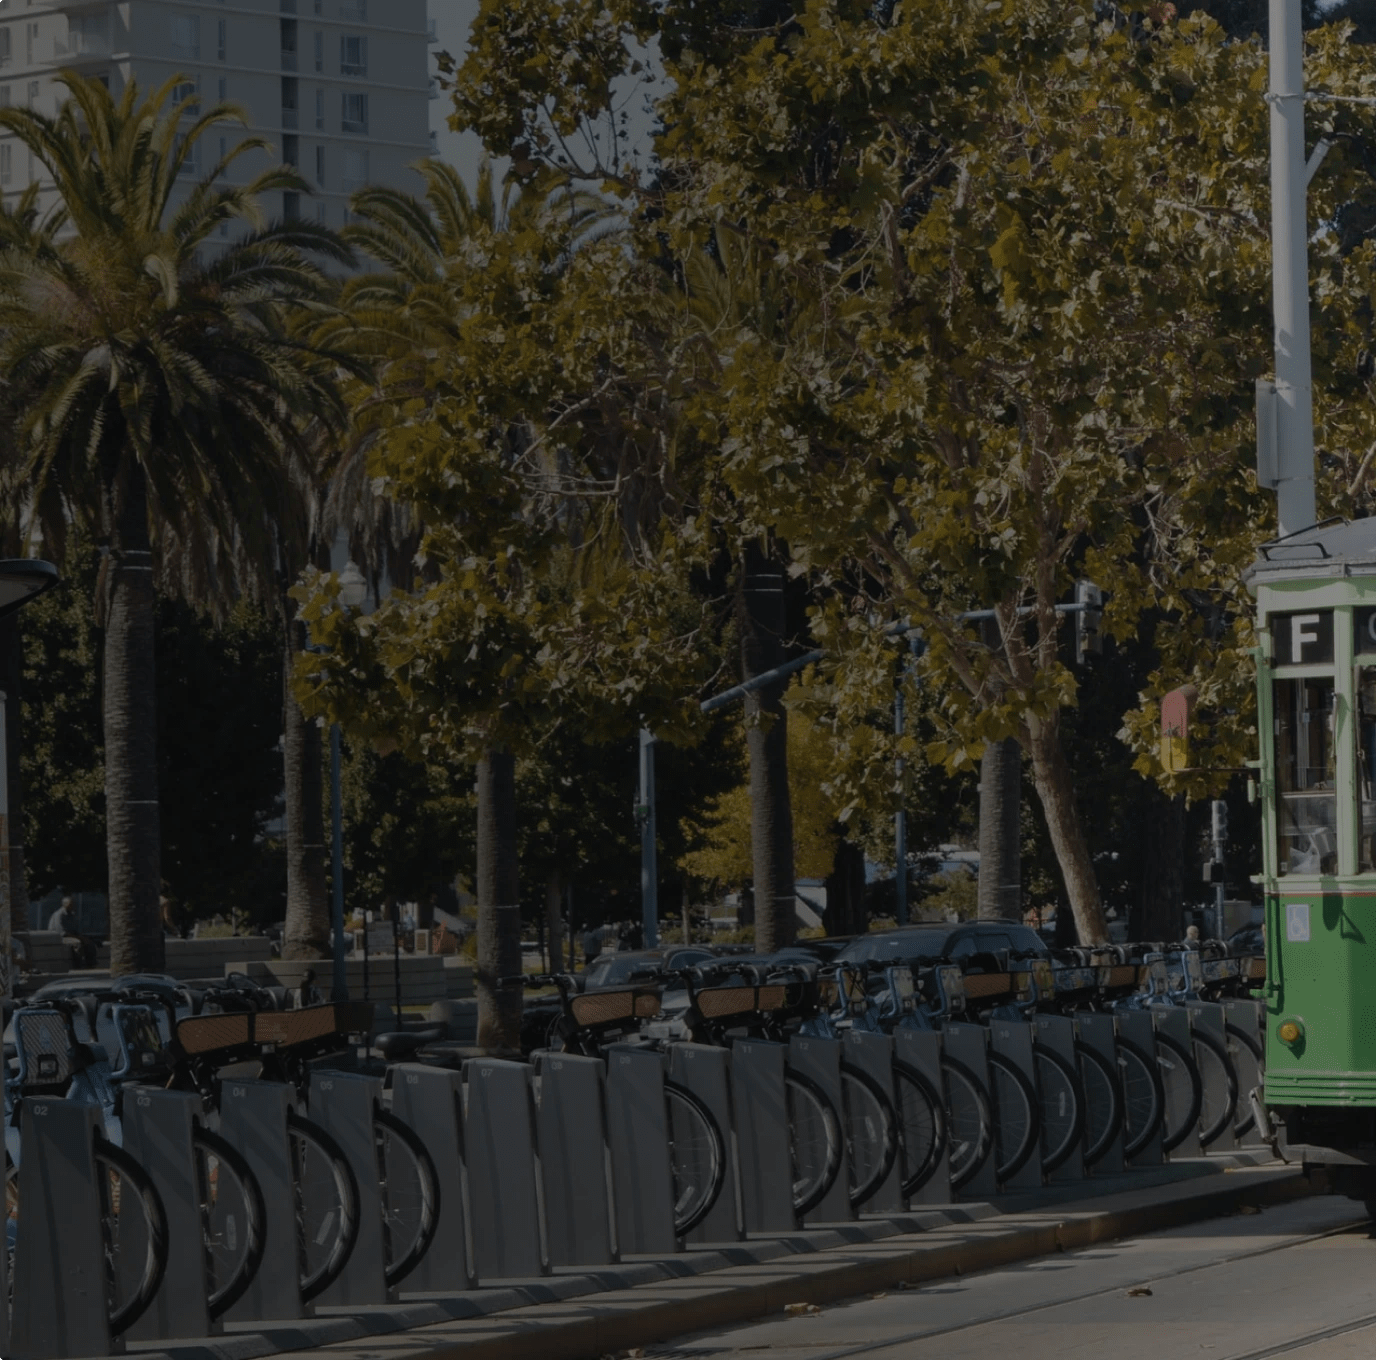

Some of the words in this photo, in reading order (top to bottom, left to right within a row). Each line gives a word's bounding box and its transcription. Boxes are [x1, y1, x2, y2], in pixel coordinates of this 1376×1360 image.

[1292, 614, 1320, 662] F
[481, 1068, 494, 1078] 07
[406, 1074, 419, 1085] 06
[320, 1080, 333, 1091] 05
[233, 1087, 246, 1098] 04
[137, 1096, 151, 1107] 03
[33, 1105, 48, 1116] 02
